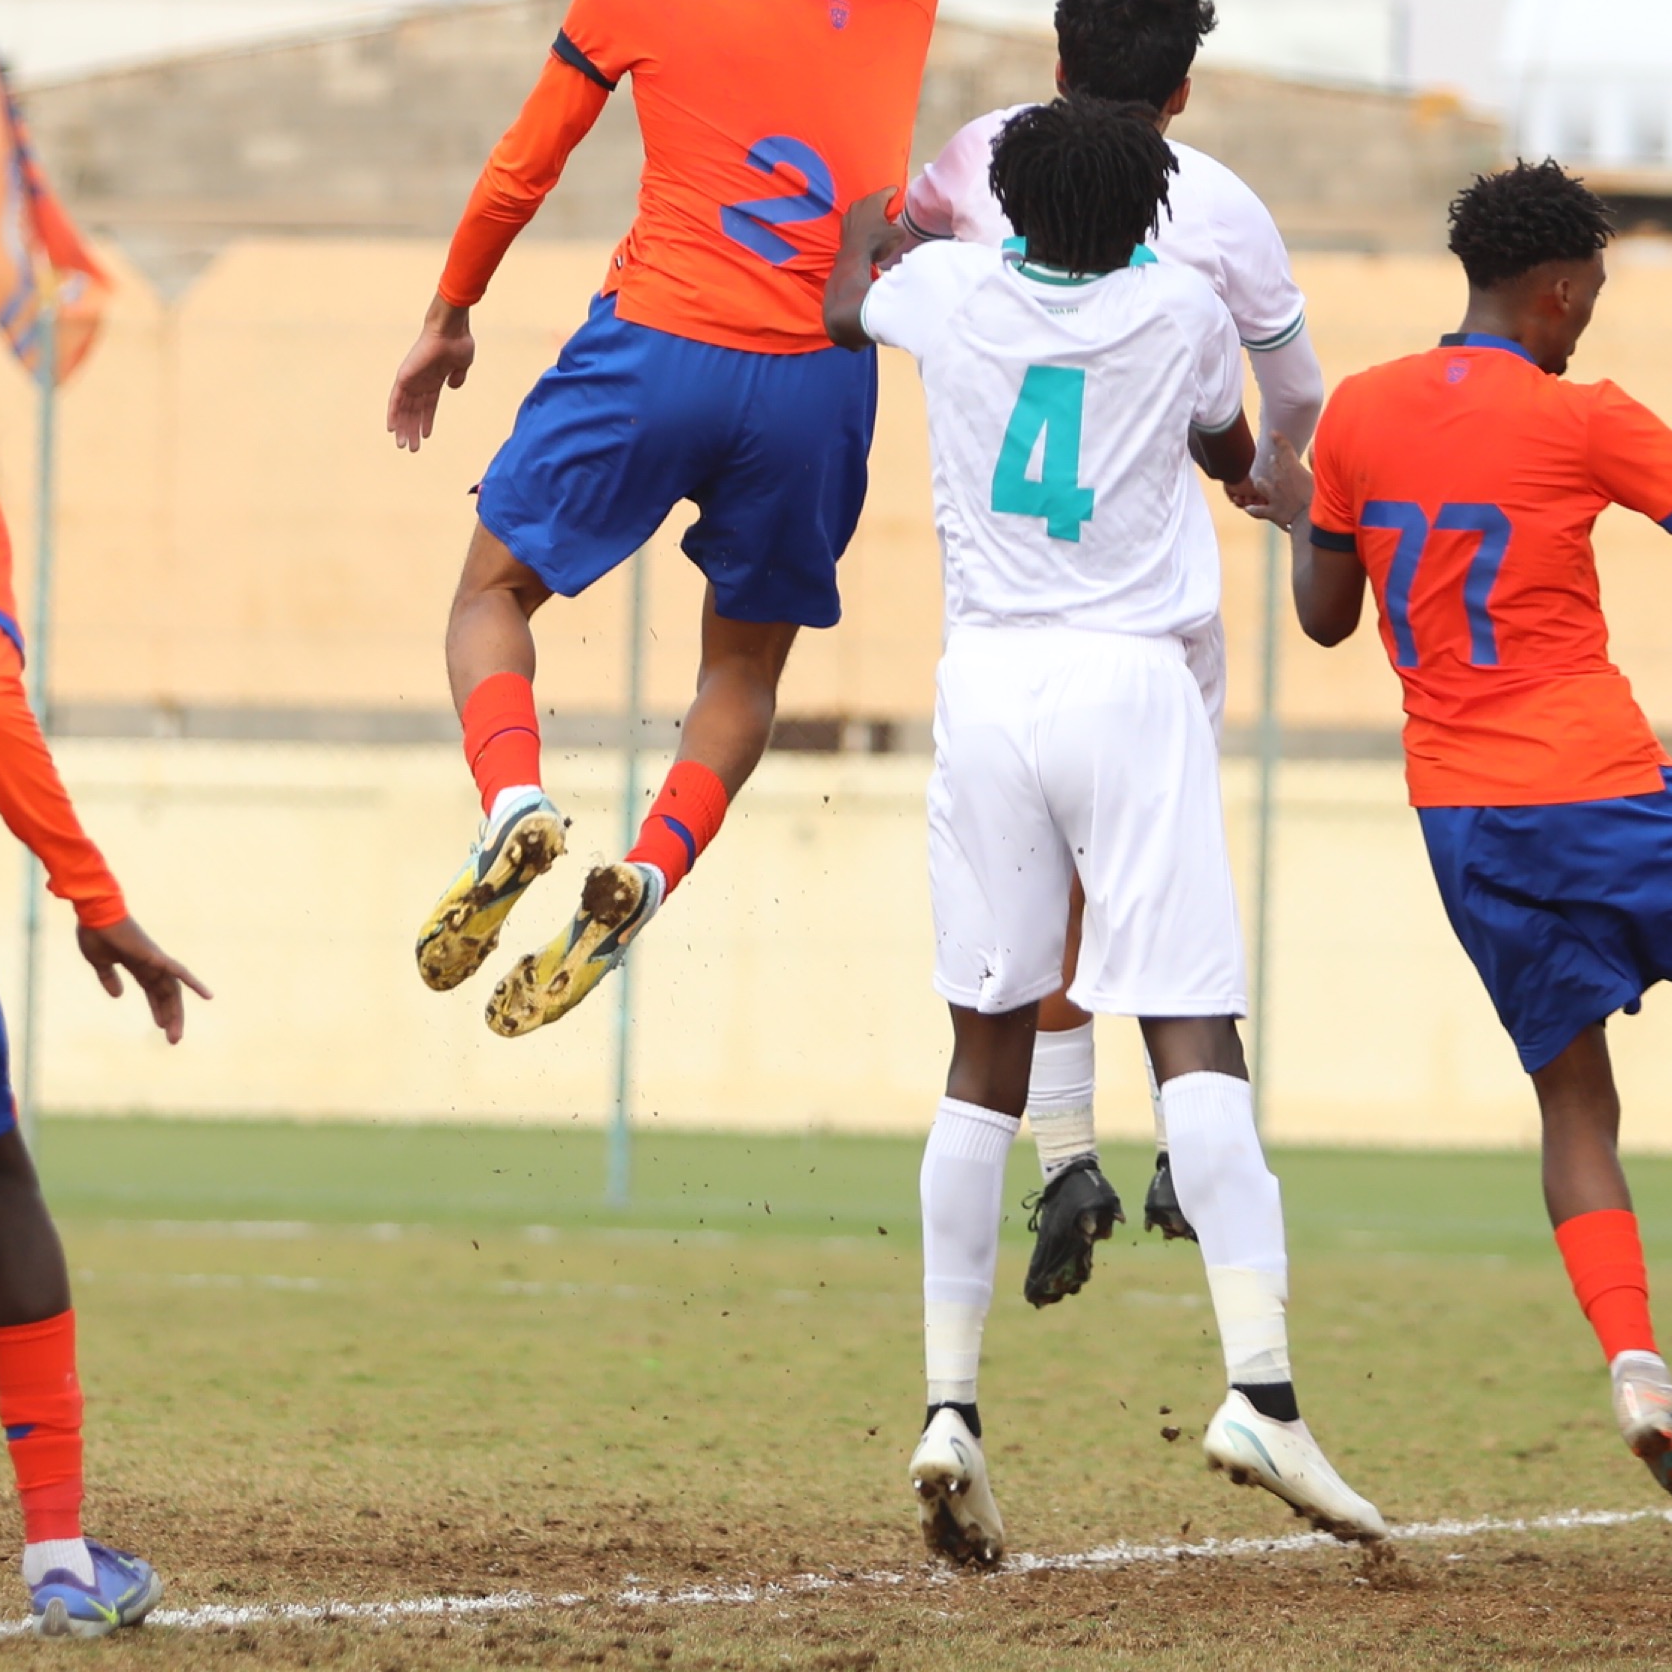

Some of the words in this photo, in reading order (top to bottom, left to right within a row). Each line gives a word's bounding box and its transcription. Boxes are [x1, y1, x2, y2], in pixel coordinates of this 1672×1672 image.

[720, 135, 835, 265] 2
[990, 364, 1096, 543] 4
[1359, 500, 1513, 667] 77
